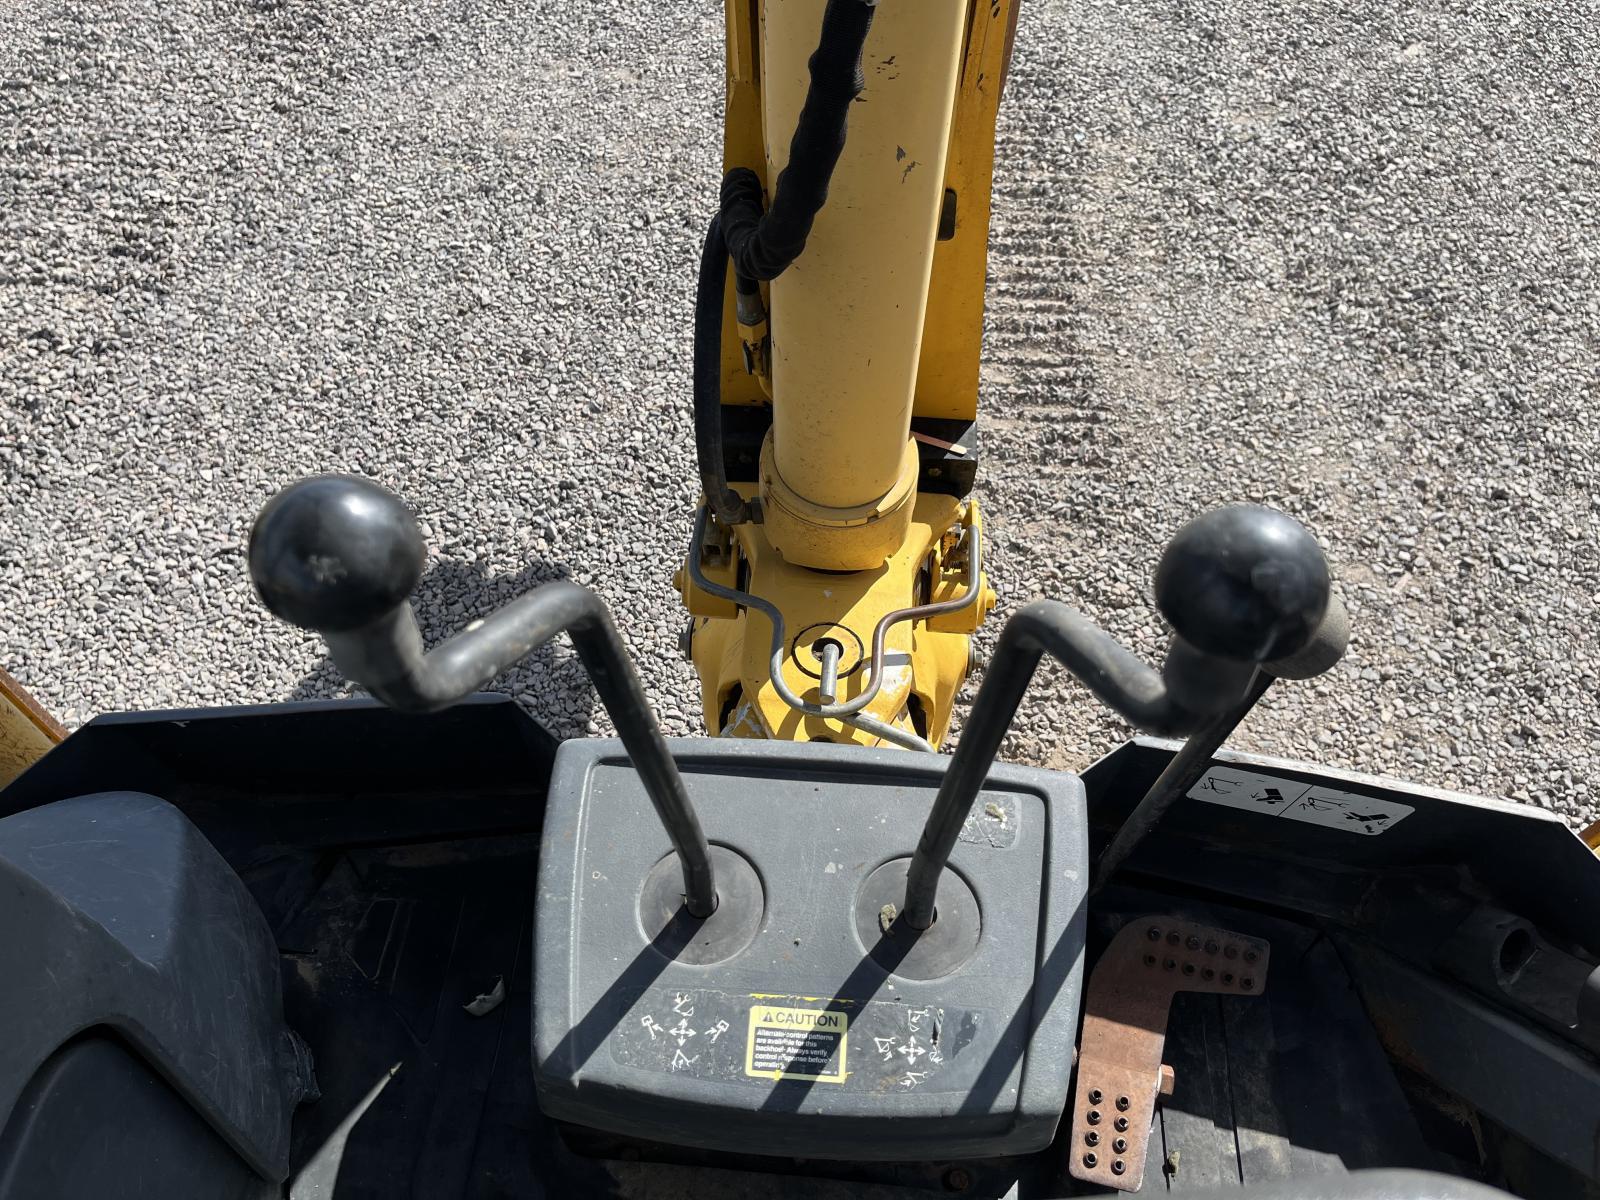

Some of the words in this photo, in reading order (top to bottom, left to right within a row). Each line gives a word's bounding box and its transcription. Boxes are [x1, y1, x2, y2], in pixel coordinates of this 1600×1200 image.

[776, 1012, 838, 1027] CAUTION
[786, 1046, 809, 1055] Always
[810, 1049, 828, 1057] verify
[808, 1056, 828, 1064] before
